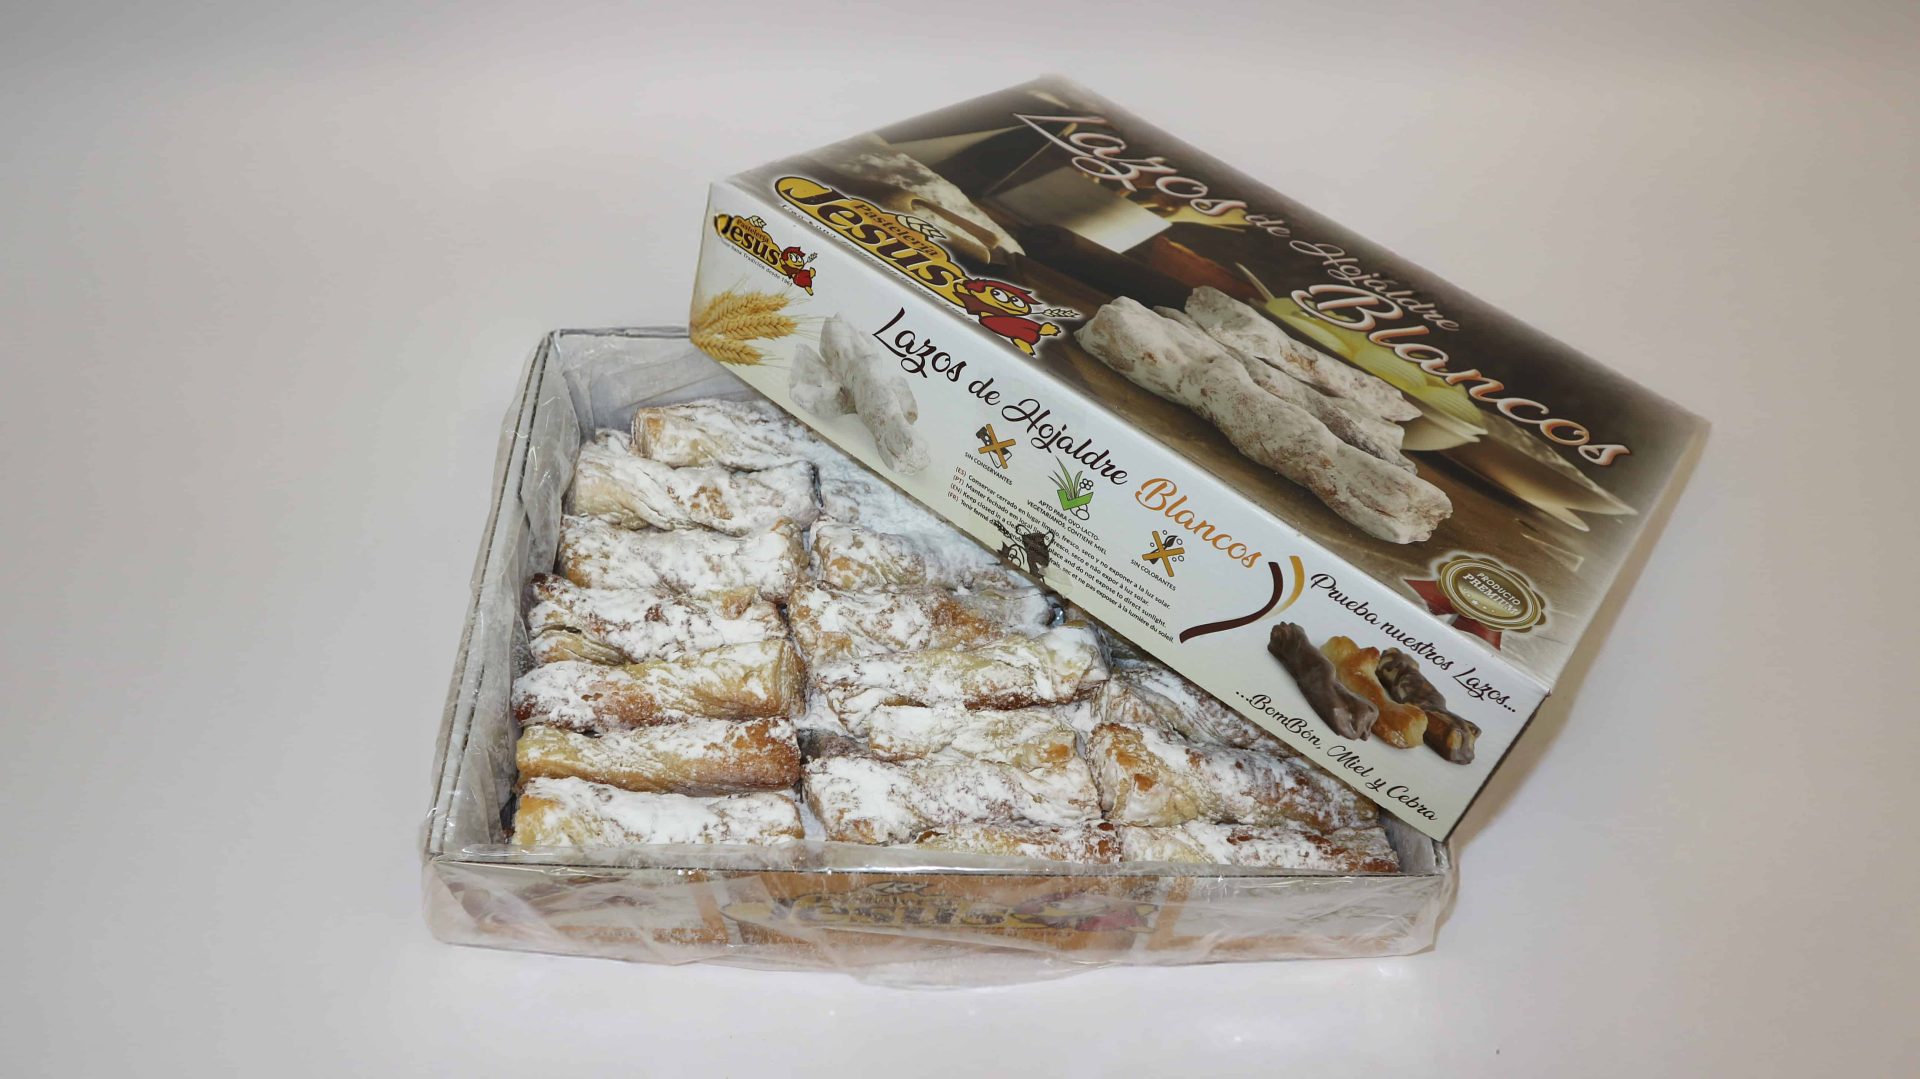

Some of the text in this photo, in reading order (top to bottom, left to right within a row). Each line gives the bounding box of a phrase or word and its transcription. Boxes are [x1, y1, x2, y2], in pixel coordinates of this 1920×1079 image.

[1013, 112, 1248, 216] Lazos
[1244, 214, 1290, 237] de
[1291, 284, 1630, 466] Blancos
[872, 307, 1263, 569] Lazos de Hojaldre Blancos
[965, 452, 1013, 485] SIN CONSERVANTES
[948, 491, 959, 502] (FR)
[960, 500, 973, 511] Tenir
[973, 508, 989, 521] fermé
[1086, 583, 1096, 591] pas
[1096, 590, 1117, 605] exposer
[1128, 610, 1149, 627] lumière
[1150, 624, 1158, 632] du
[950, 482, 962, 494] (EN)
[963, 492, 977, 504] Keep
[977, 501, 995, 517] closed
[1048, 548, 1063, 560] place
[1064, 558, 1075, 568] and
[1076, 565, 1084, 573] do
[1084, 572, 1095, 581] not
[1096, 579, 1116, 594] expose
[1124, 596, 1141, 610] direct
[1142, 609, 1166, 628] sunlight.
[953, 475, 964, 485] (PT)
[965, 483, 986, 499] Manter
[987, 495, 1008, 514] fechado
[1009, 512, 1018, 520] em
[1019, 518, 1033, 530] local
[1071, 552, 1084, 563] seco
[1090, 564, 1101, 574] não
[1102, 572, 1118, 586] expor
[1124, 587, 1133, 595] luz
[1133, 593, 1149, 606] solar.
[956, 466, 966, 477] (ES)
[968, 475, 996, 496] Conservar
[997, 494, 1018, 509] cerrado
[1027, 512, 1040, 525] lugar
[1062, 535, 1080, 551] fresco,
[1082, 549, 1094, 560] seco
[1109, 567, 1133, 585] exponer
[1146, 590, 1154, 599] luz
[1155, 596, 1171, 609] solar.
[1027, 500, 1066, 530] VEGETARIANOS,
[1067, 526, 1094, 546] CONTIENE
[1094, 544, 1107, 555] MIEL
[1039, 500, 1099, 541] APTO PARA OVO-LACTO-
[1130, 559, 1176, 591] SIN COLORANTES
[1311, 573, 1516, 713] Prueba nuestros Lazos...
[1463, 574, 1518, 615] PREMIUM
[1476, 572, 1520, 606] PRODUCTO
[1327, 745, 1374, 778] Miel
[1365, 778, 1386, 792] y
[1387, 785, 1439, 821] Cebra
